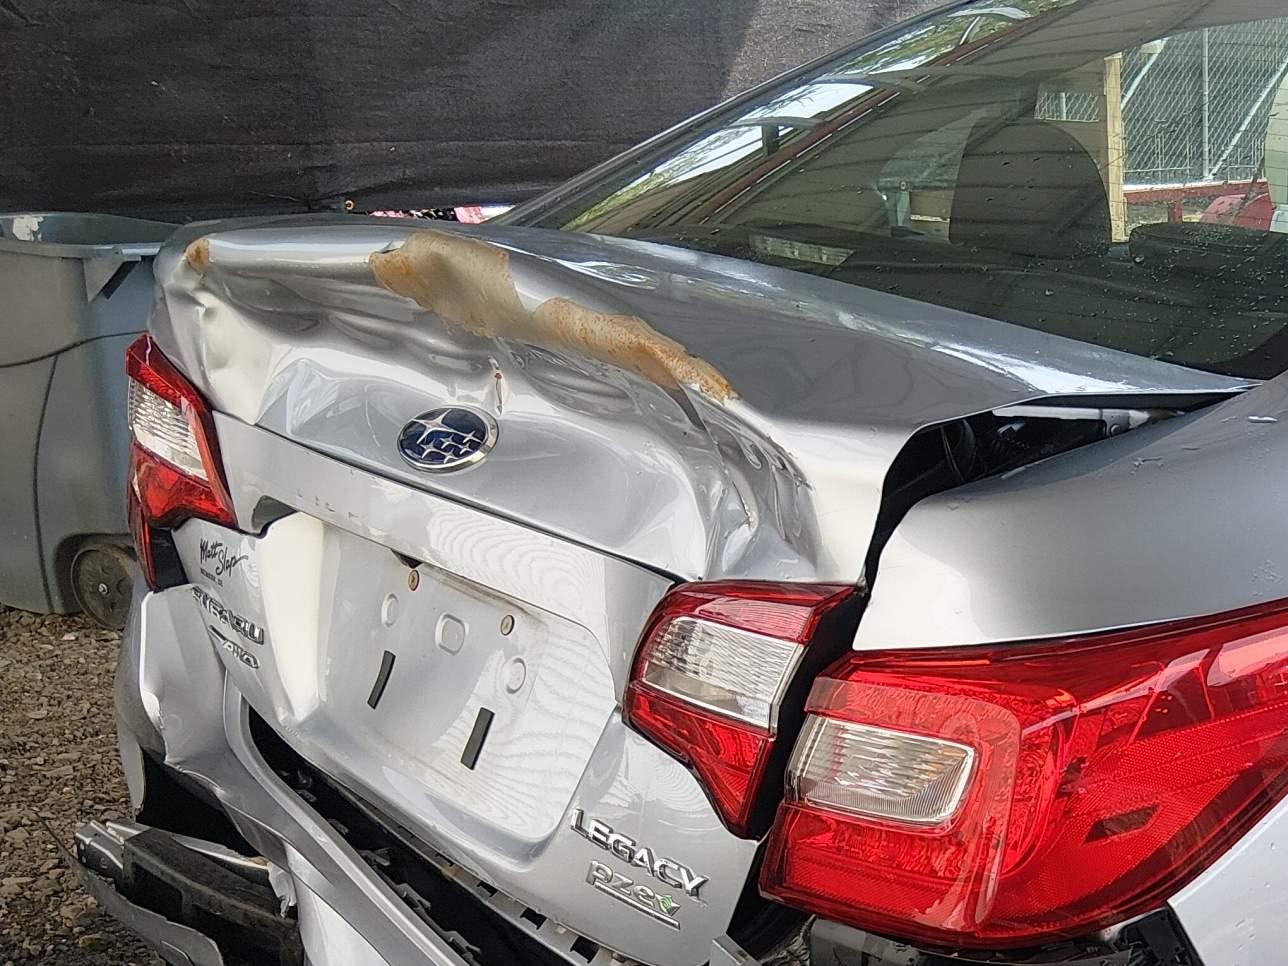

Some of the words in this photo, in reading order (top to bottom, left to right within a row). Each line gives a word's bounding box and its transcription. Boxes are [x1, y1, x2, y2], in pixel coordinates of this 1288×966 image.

[200, 538, 223, 563] Matt
[191, 586, 265, 645] SUBARU
[570, 808, 710, 897] LEGACY
